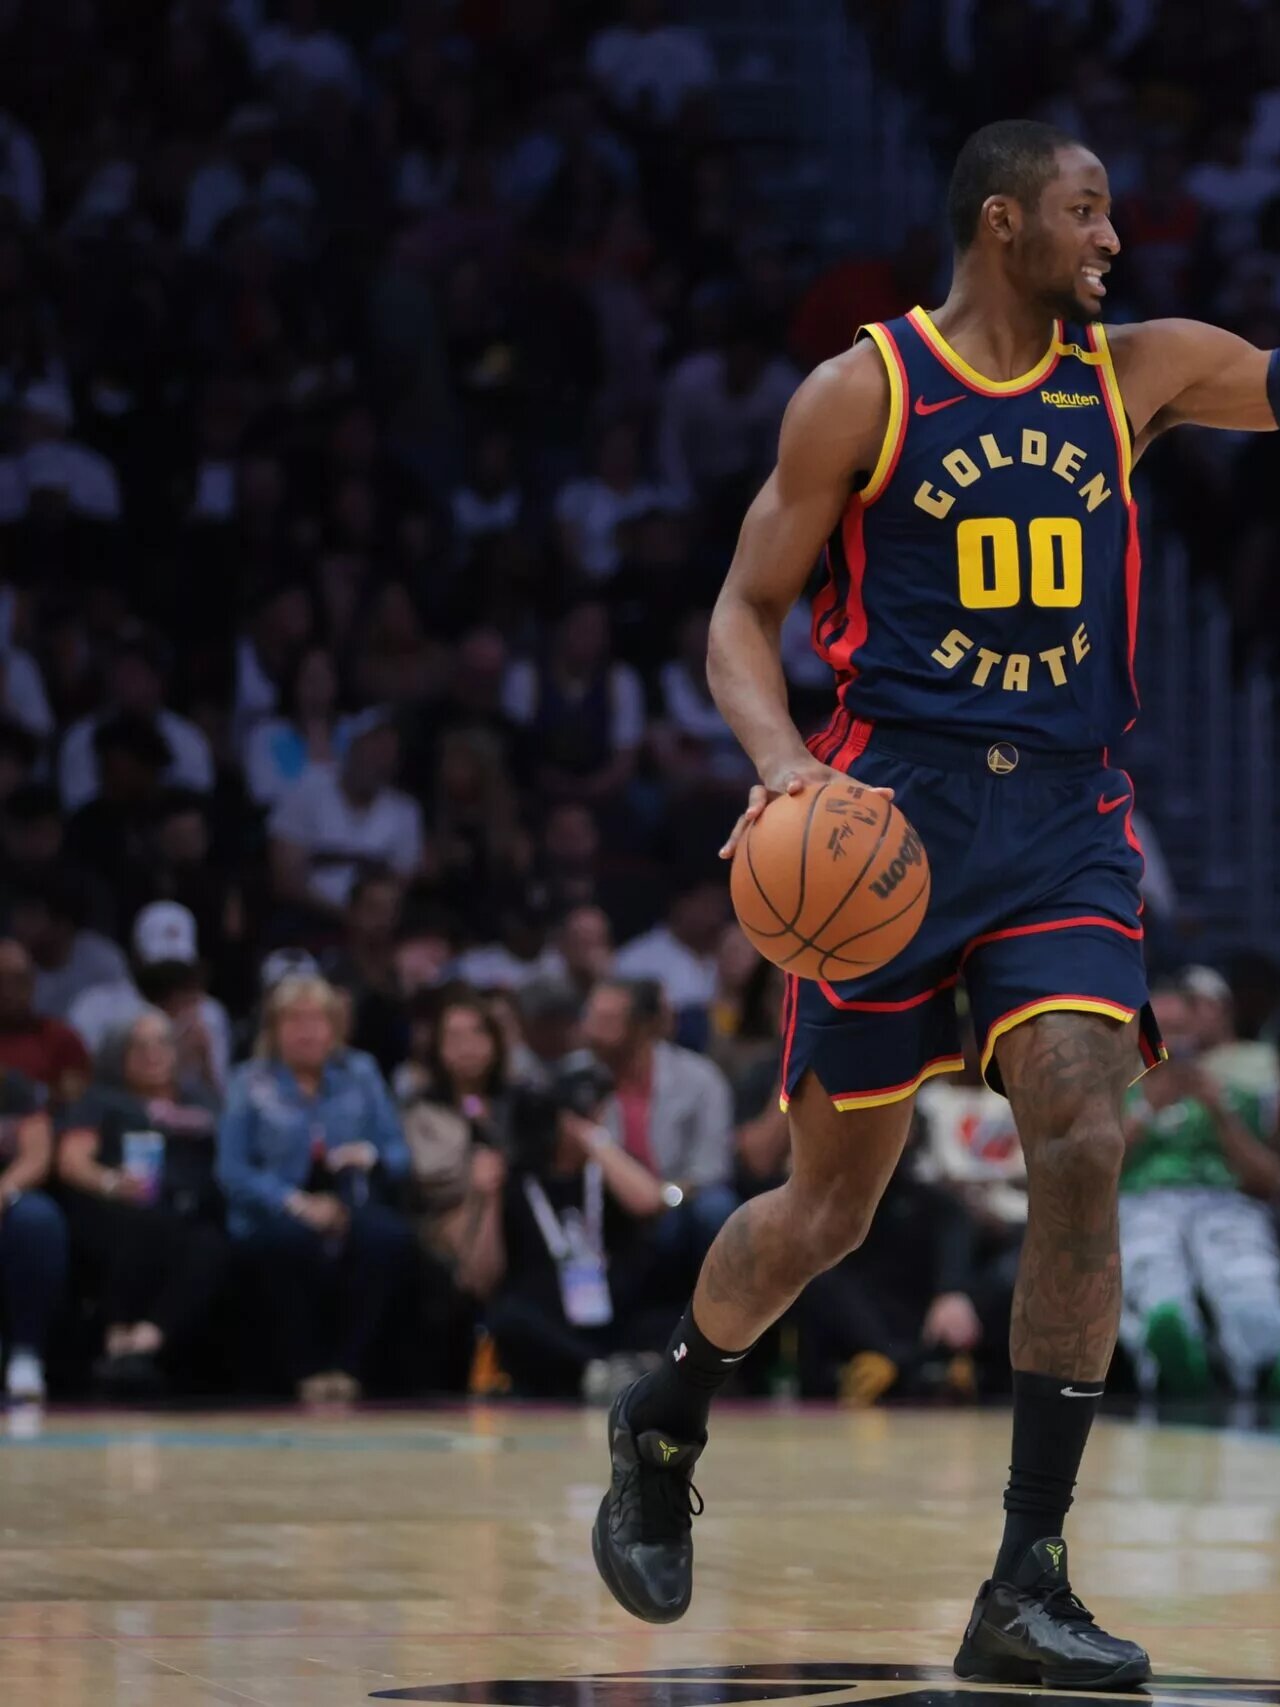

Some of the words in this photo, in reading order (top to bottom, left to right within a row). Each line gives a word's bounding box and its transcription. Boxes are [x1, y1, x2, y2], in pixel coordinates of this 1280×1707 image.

[1041, 391, 1099, 408] Rakuten
[914, 428, 1112, 520] GOLDEN
[956, 517, 1083, 610] 00
[931, 622, 1092, 692] STATE
[868, 823, 923, 898] lson
